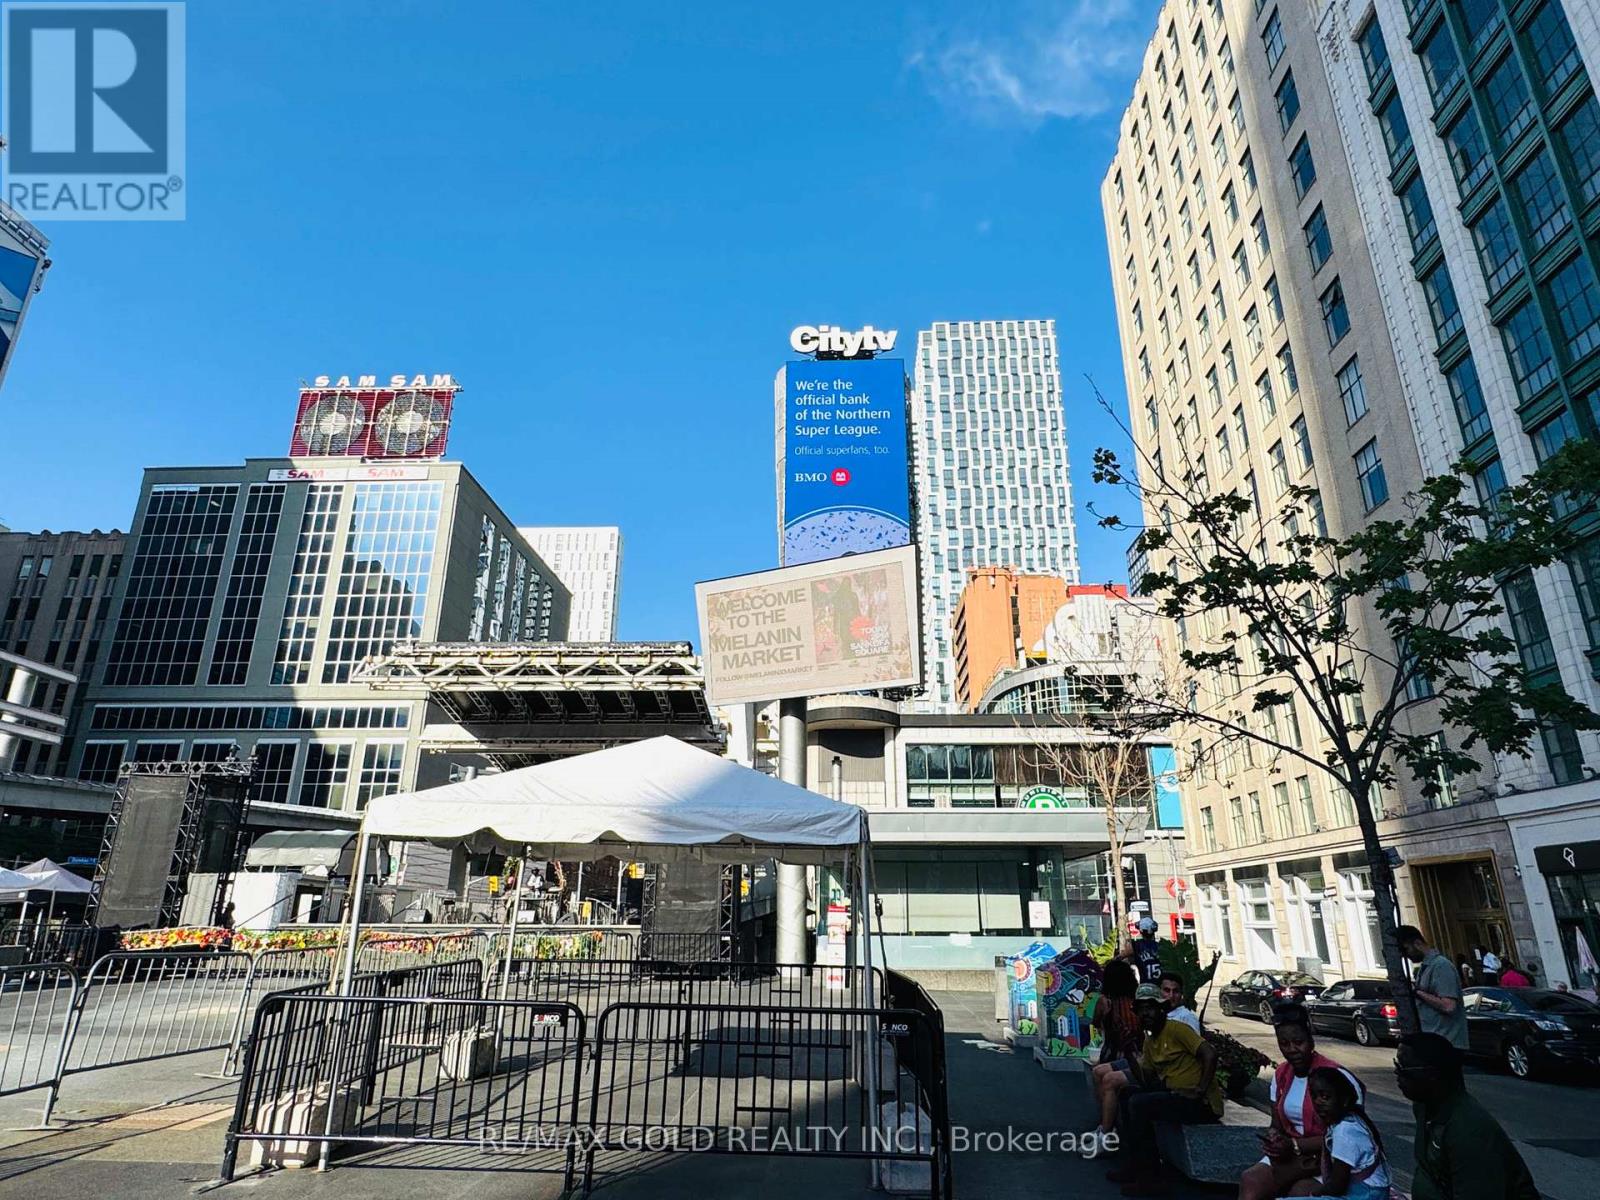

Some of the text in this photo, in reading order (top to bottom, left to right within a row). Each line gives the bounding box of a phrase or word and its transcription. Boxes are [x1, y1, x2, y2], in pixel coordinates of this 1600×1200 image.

[790, 325, 898, 357] Citytv
[314, 374, 452, 387] SAM SAM
[795, 379, 853, 391] We're the
[795, 393, 870, 406] official bank
[795, 408, 891, 421] of the Northern
[795, 424, 881, 438] Super League.
[794, 445, 890, 457] Official superfans, too.
[287, 468, 324, 479] SAM
[368, 468, 405, 478] SAM
[794, 472, 827, 482] BMO
[717, 588, 807, 617] WELCOME
[727, 608, 786, 630] TO THE
[712, 625, 802, 653] MELANIN
[721, 644, 805, 671] MARKET
[1146, 963, 1162, 980] 15
